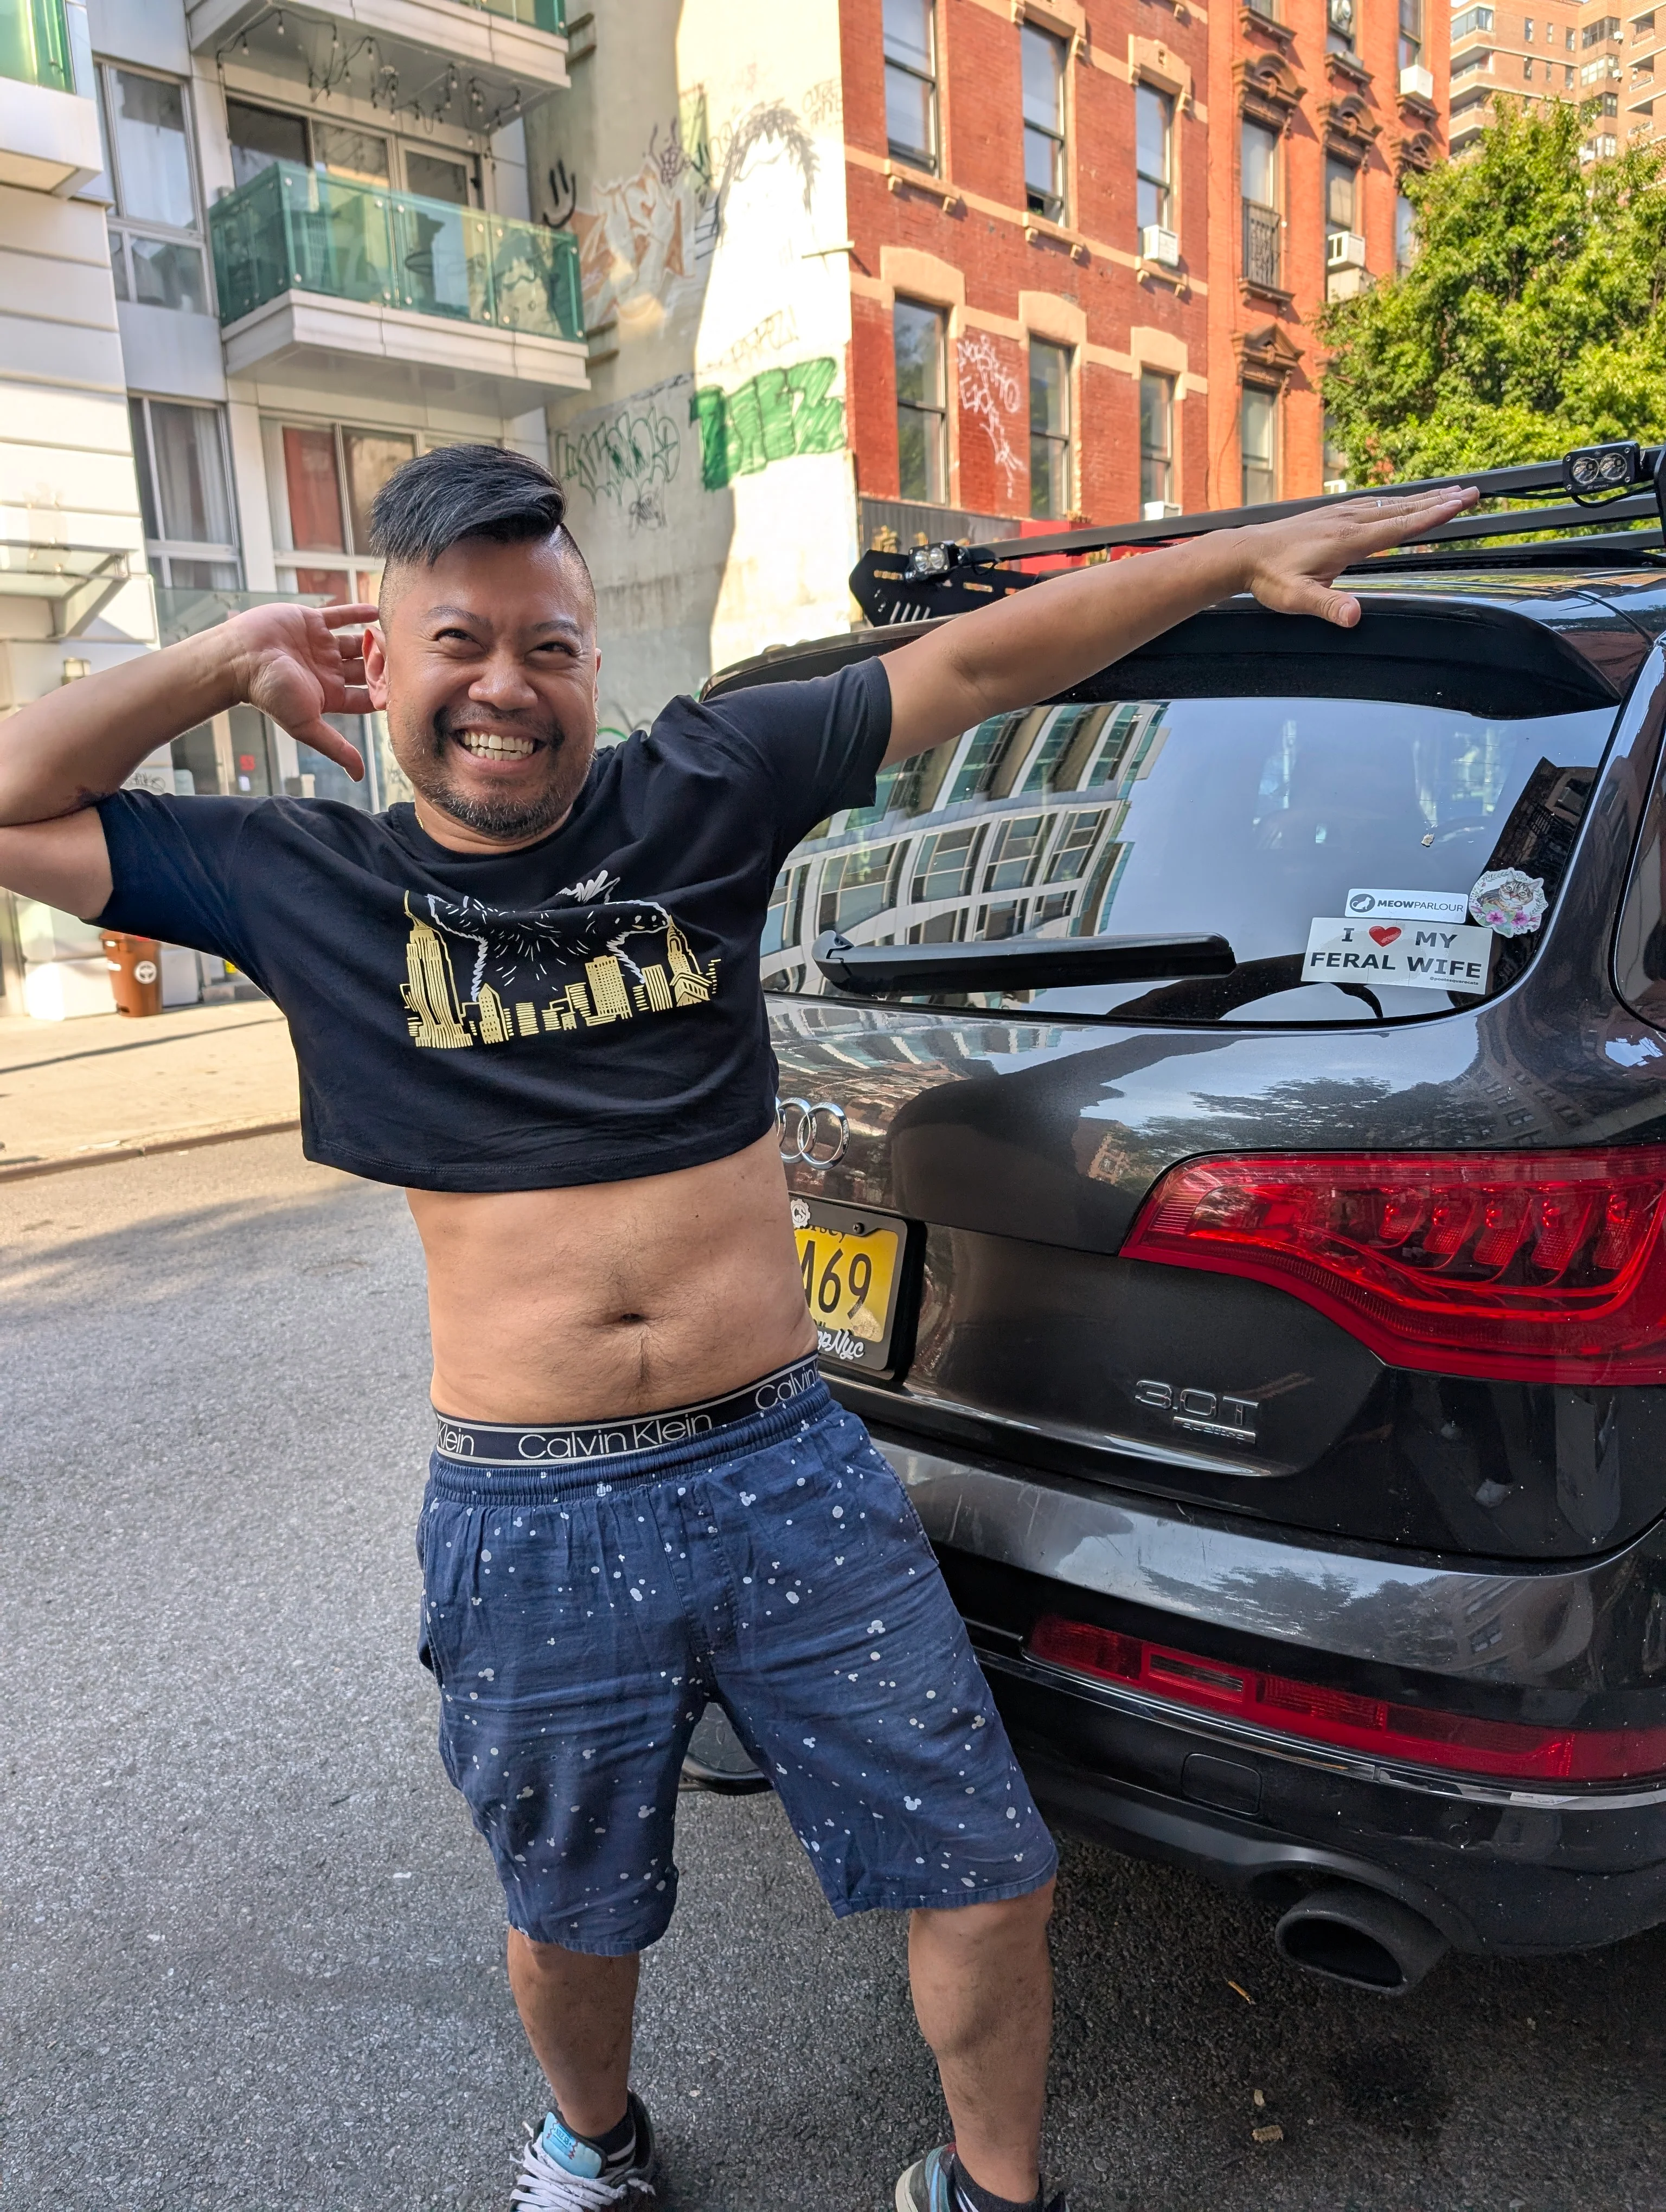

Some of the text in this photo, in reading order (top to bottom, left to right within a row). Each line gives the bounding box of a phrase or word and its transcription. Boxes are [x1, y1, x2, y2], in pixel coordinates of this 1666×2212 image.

[1377, 900, 1463, 912] MEOWPARLOUR
[1341, 927, 1458, 949] I MY
[1310, 952, 1482, 979] FERAL WIFE
[755, 1366, 815, 1410] Calvin
[437, 1420, 475, 1456] Klein
[518, 1413, 713, 1459] Calvin Klein
